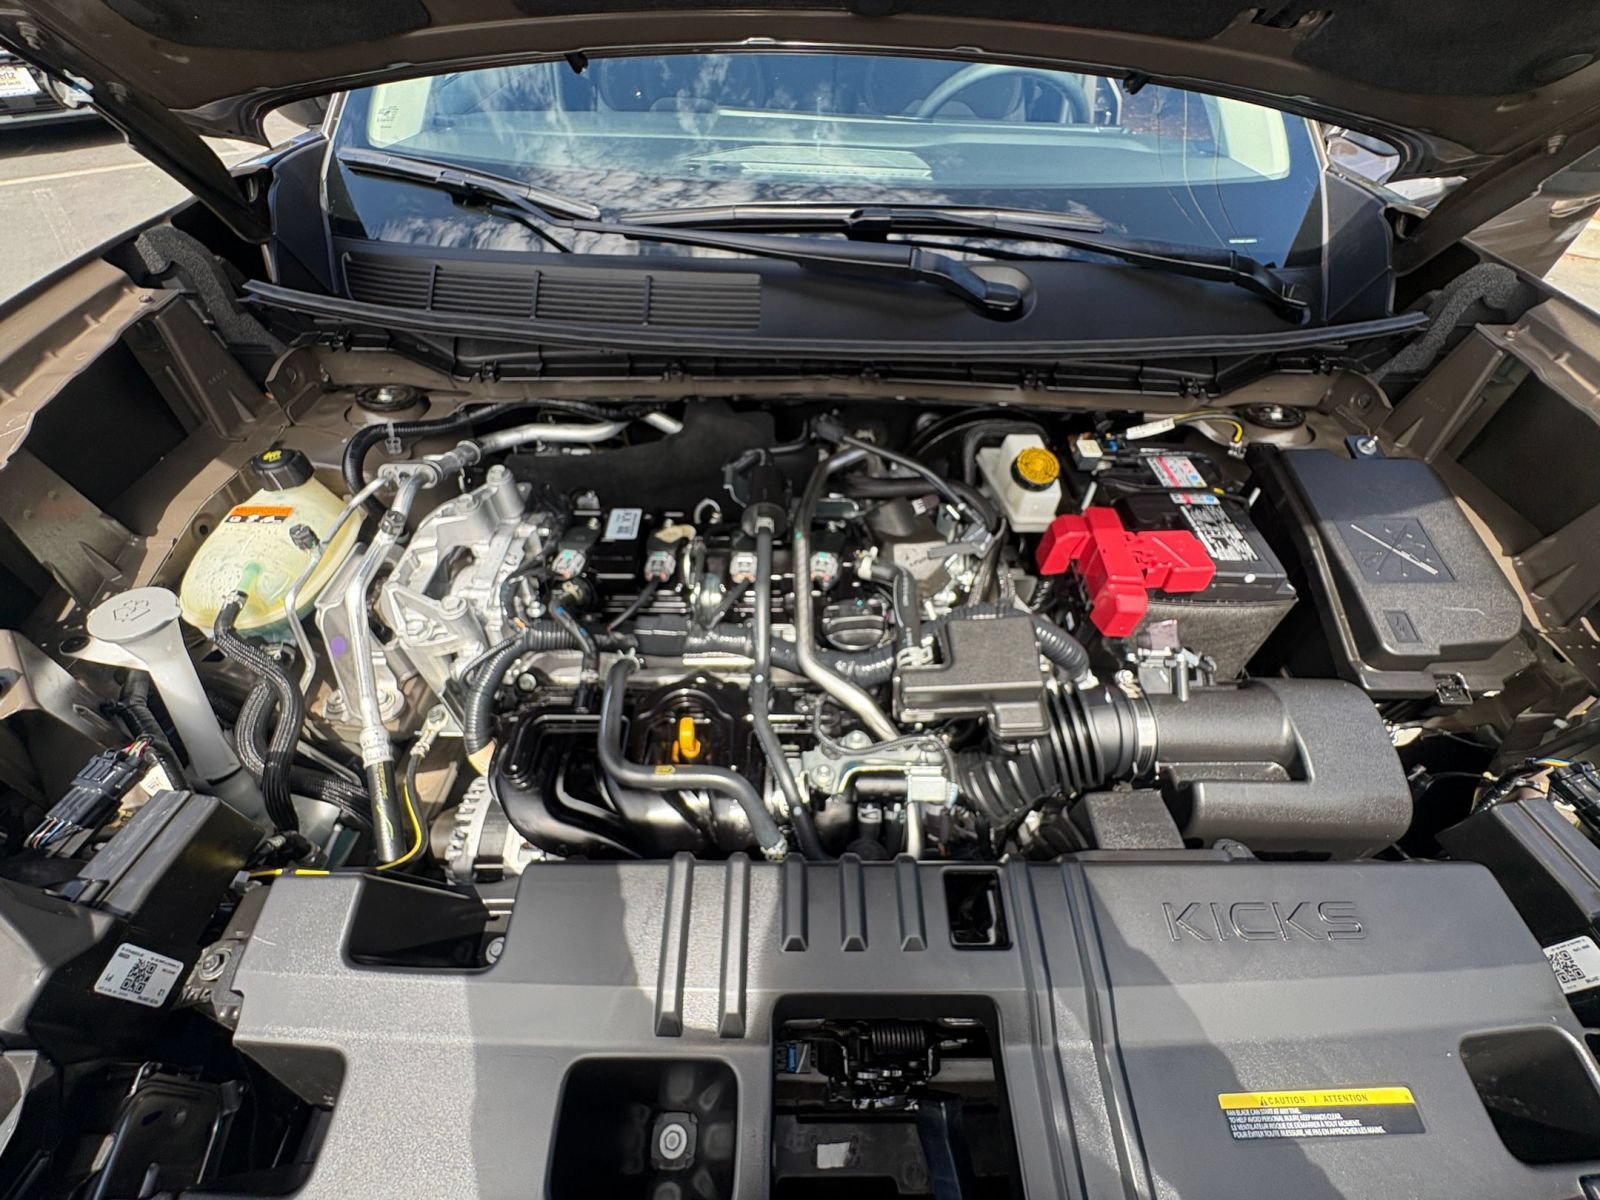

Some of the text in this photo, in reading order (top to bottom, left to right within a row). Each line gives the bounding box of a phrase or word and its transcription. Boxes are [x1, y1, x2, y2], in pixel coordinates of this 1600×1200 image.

[1161, 901, 1366, 941] KICKS
[1268, 1096, 1306, 1105] CAUTION
[1323, 1093, 1369, 1103] ATTENTION
